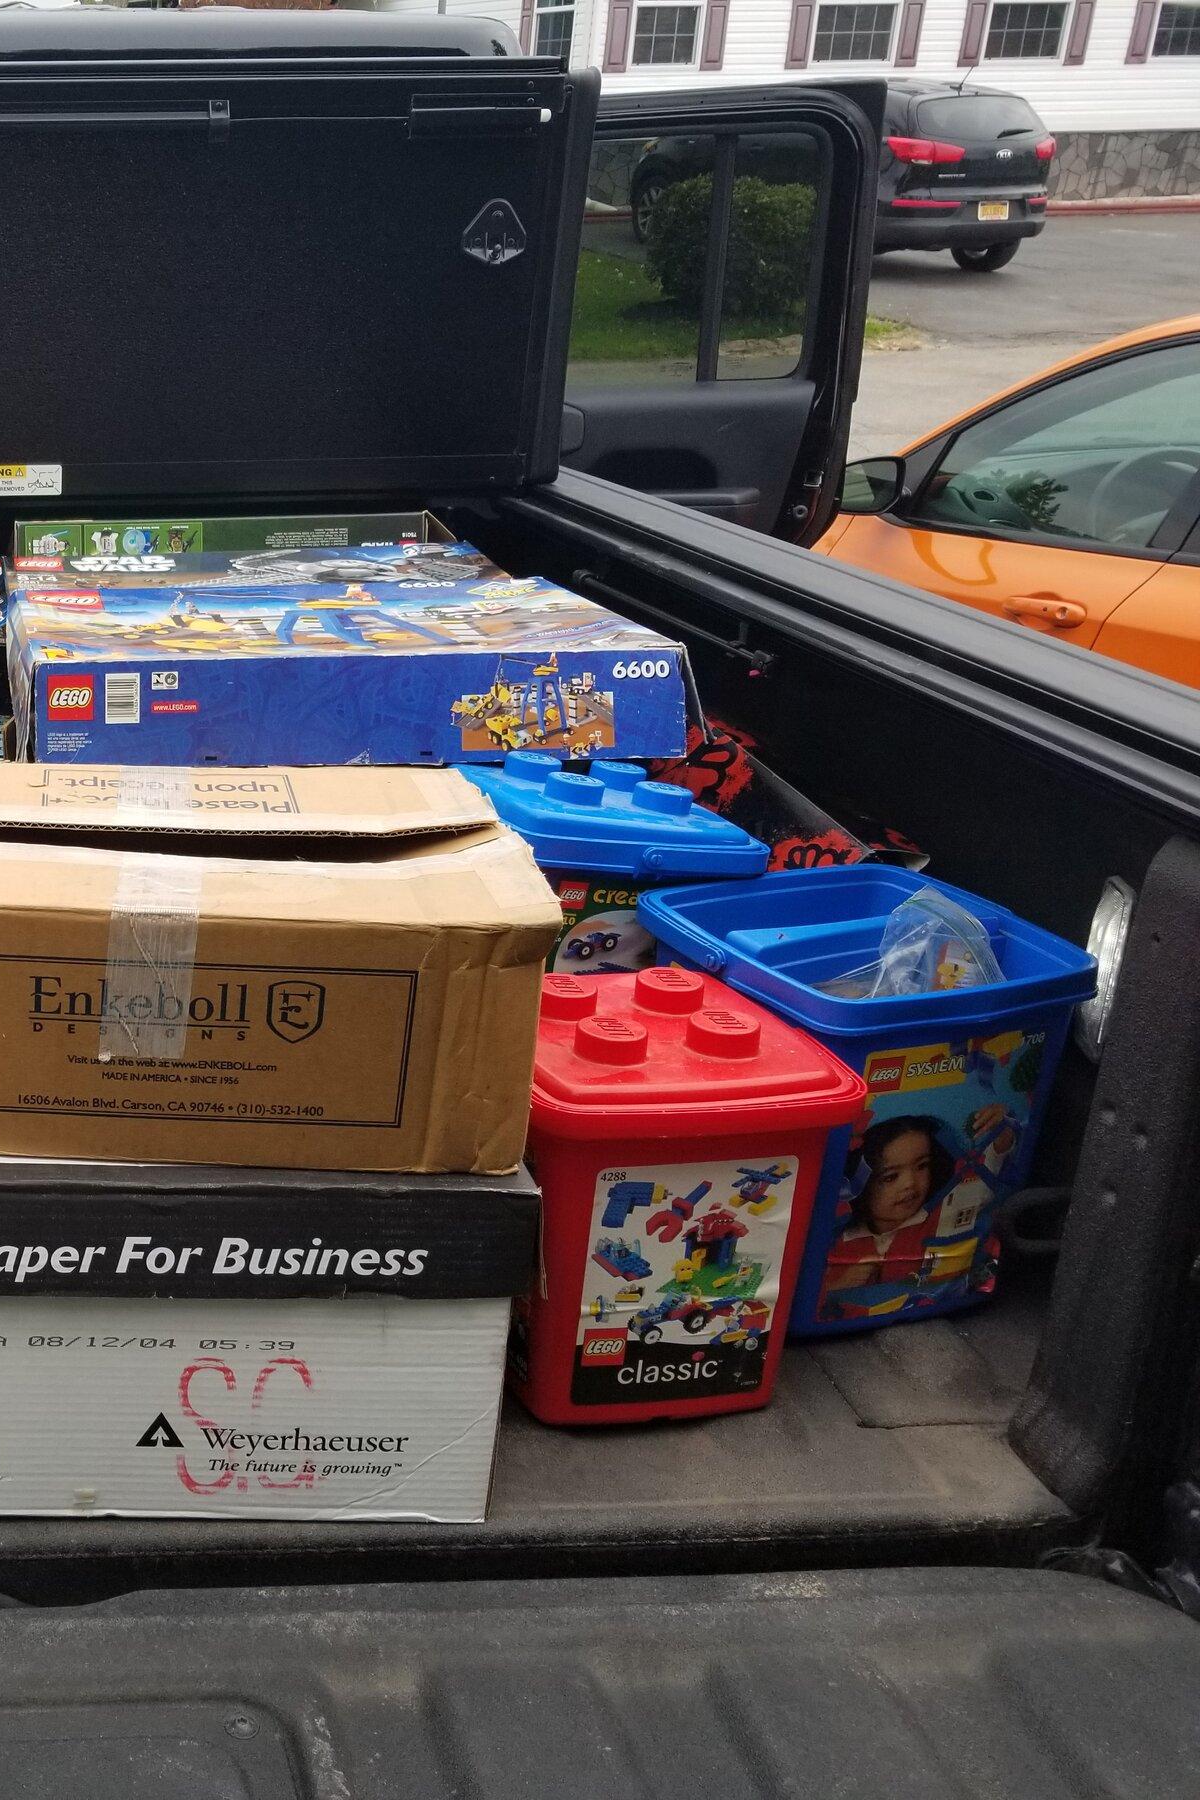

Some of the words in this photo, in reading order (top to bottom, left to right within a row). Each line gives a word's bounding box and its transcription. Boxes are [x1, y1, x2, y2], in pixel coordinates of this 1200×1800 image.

[16, 559, 62, 568] LEGO
[80, 556, 171, 564] STAR
[70, 563, 177, 572] WARS
[398, 580, 456, 589] 6600
[30, 593, 100, 606] LEGO
[611, 659, 671, 680] 6600
[50, 687, 92, 708] LEGO
[153, 703, 198, 713] www.LEGO.com
[194, 783, 280, 793] upon
[191, 800, 292, 814] Please
[561, 888, 586, 901] LEGO
[29, 976, 250, 1023] Enkeboll
[67, 1055, 88, 1065] Visit
[90, 1058, 101, 1066] us
[118, 1058, 134, 1067] the
[136, 1058, 156, 1068] web
[171, 1061, 277, 1072] www.ENKEBOLL.com
[869, 1068, 901, 1084] LEGO
[906, 1055, 965, 1077] SYSTEM
[102, 1071, 128, 1082] MADE
[130, 1073, 140, 1082] IN
[140, 1073, 182, 1083] AMERICA
[190, 1075, 217, 1085] SINCE
[220, 1076, 239, 1085] 1956
[17, 1094, 50, 1106] 16506
[51, 1095, 90, 1108] Avalon
[93, 1097, 118, 1109] Blvd.
[121, 1099, 164, 1112] Carson,
[168, 1101, 186, 1112] CA
[190, 1102, 225, 1114] 90746
[236, 1103, 324, 1117] (310)-532-1400
[600, 1172, 627, 1182] 4288
[115, 1236, 203, 1276] For
[212, 1237, 429, 1277] Business
[27, 1336, 177, 1350] 08/12/04
[585, 1338, 626, 1356] LEGO
[200, 1428, 410, 1457] Weyerhaeuser
[209, 1459, 240, 1472] The
[245, 1459, 297, 1473] future
[302, 1460, 317, 1474] is
